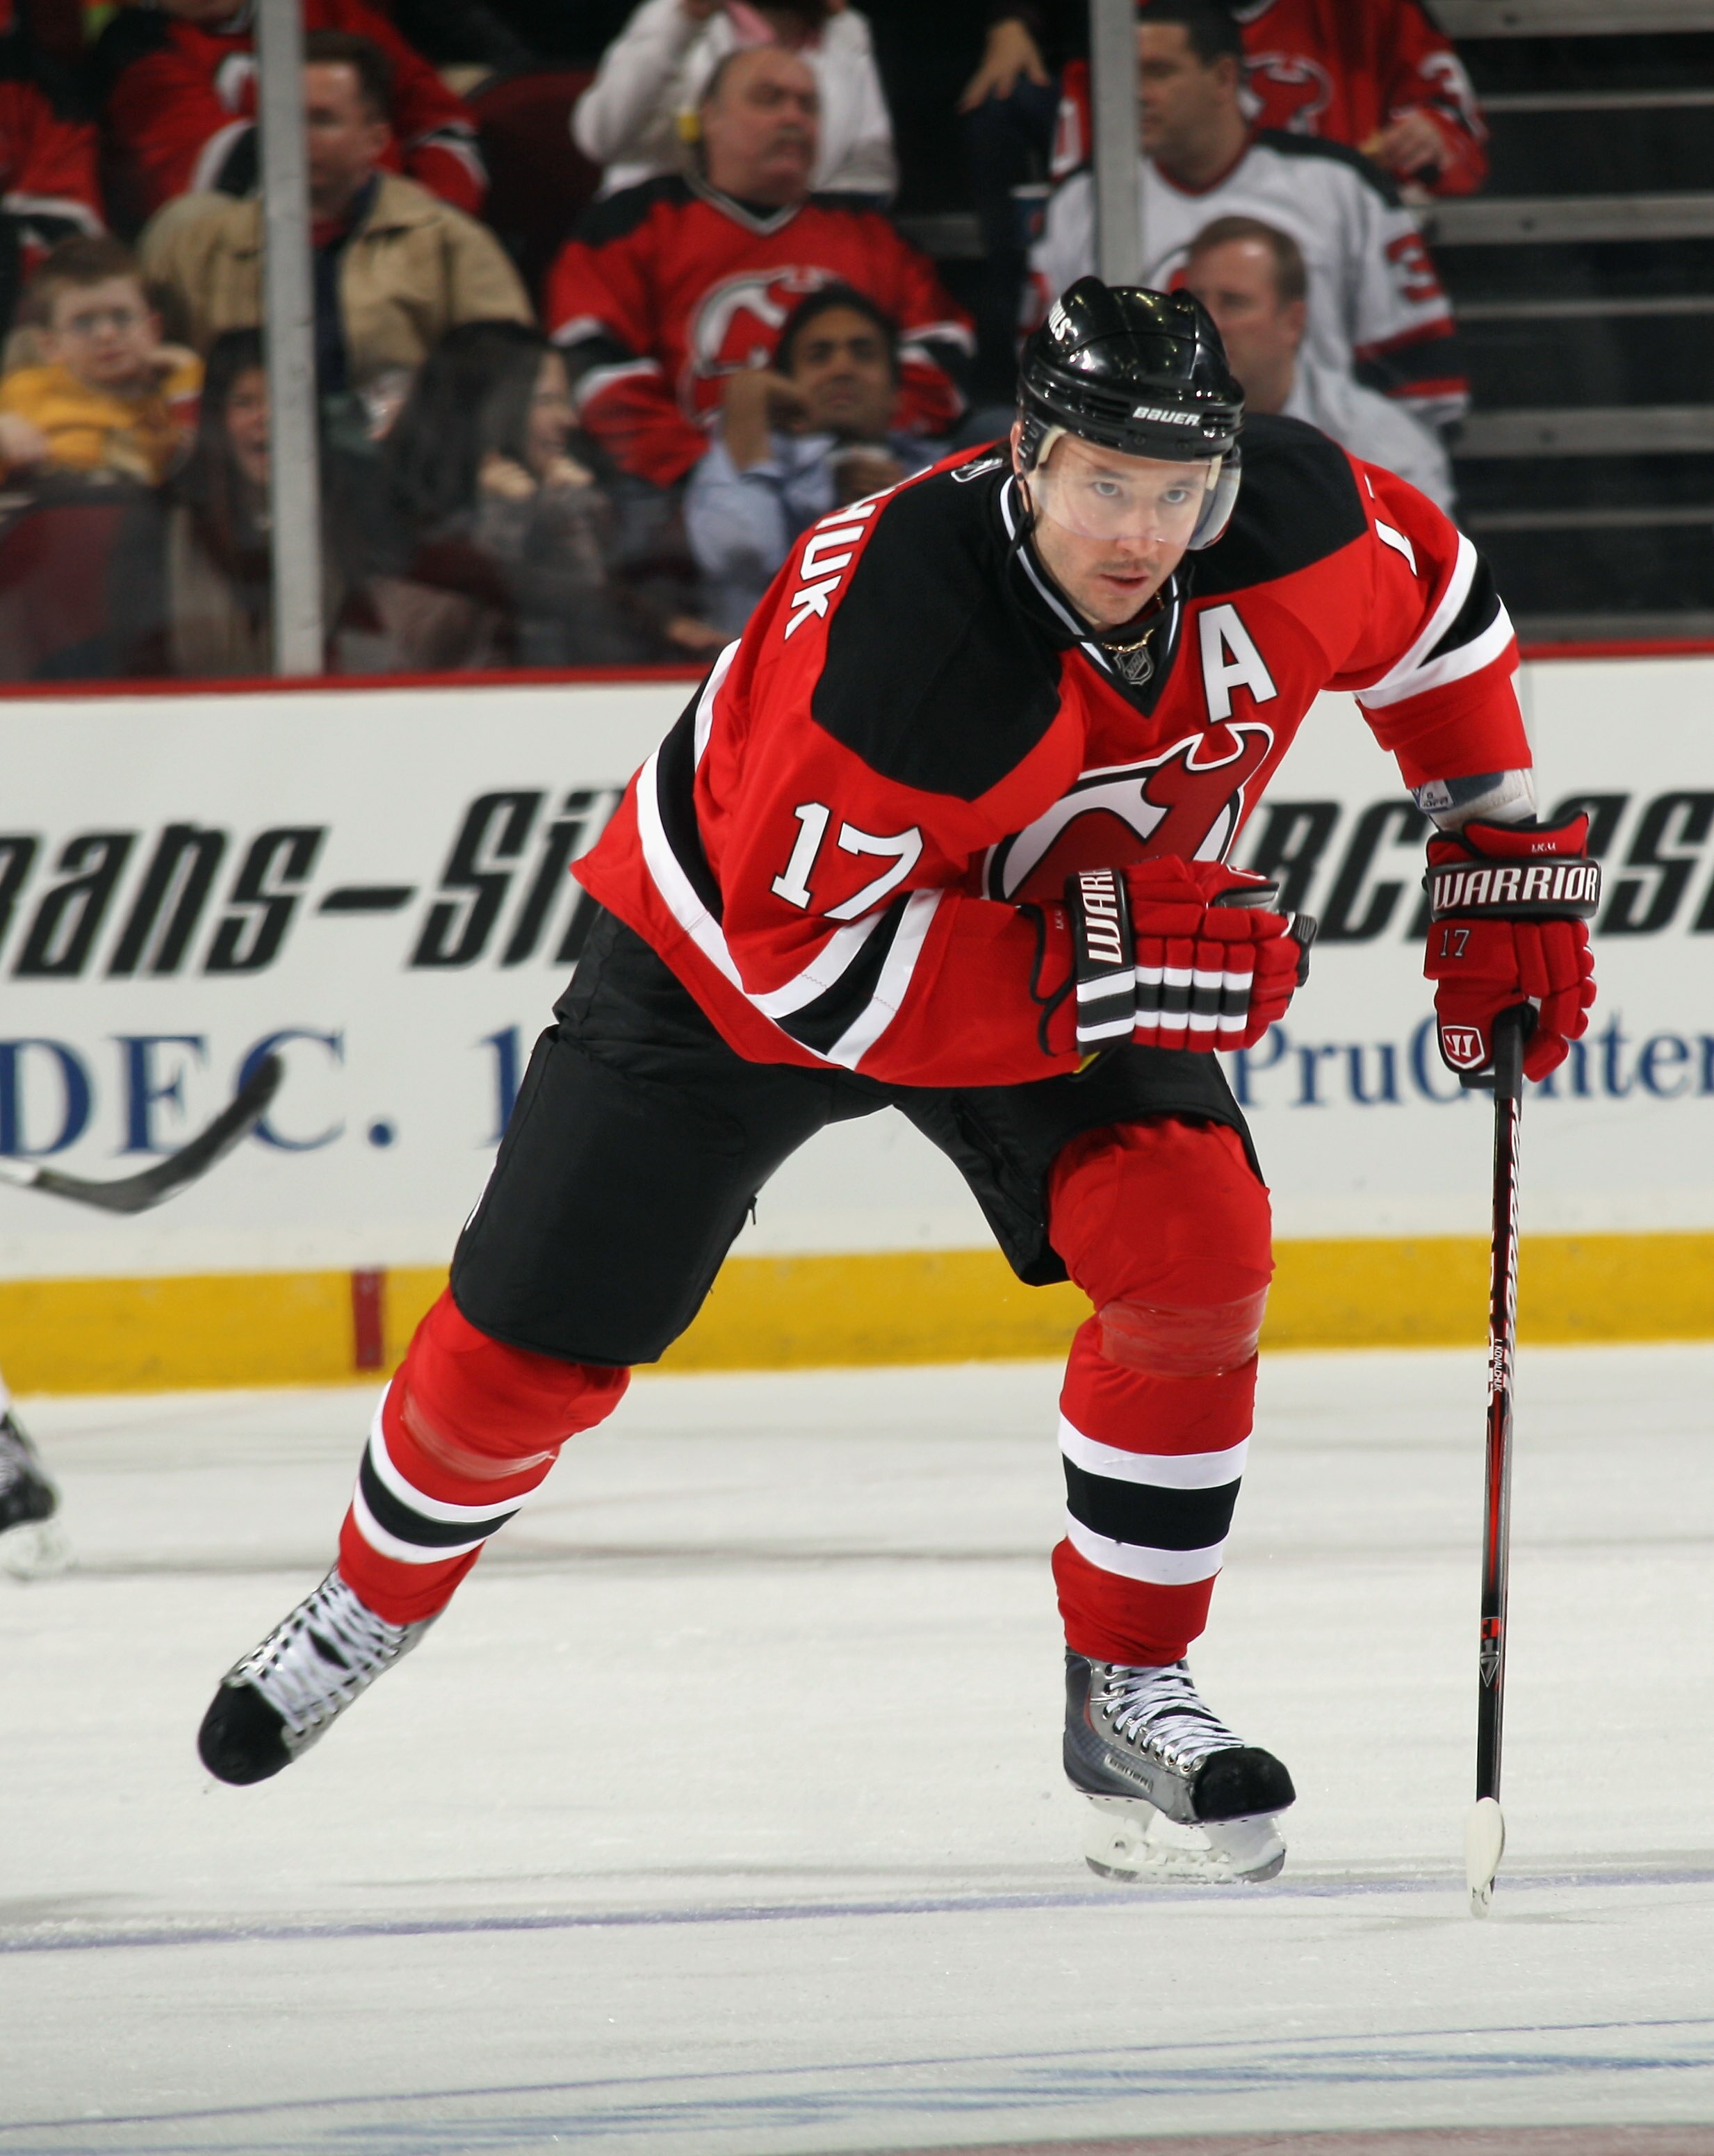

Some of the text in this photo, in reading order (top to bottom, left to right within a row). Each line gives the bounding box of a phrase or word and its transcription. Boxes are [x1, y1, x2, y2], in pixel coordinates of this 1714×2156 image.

[1132, 406, 1201, 427] BAUER
[1198, 603, 1278, 724] A
[0, 786, 623, 974] ans-Si
[770, 801, 921, 919] 17
[1433, 867, 1598, 911] WARRIOR
[1439, 929, 1470, 958] 17
[0, 1027, 398, 1155] DEC.
